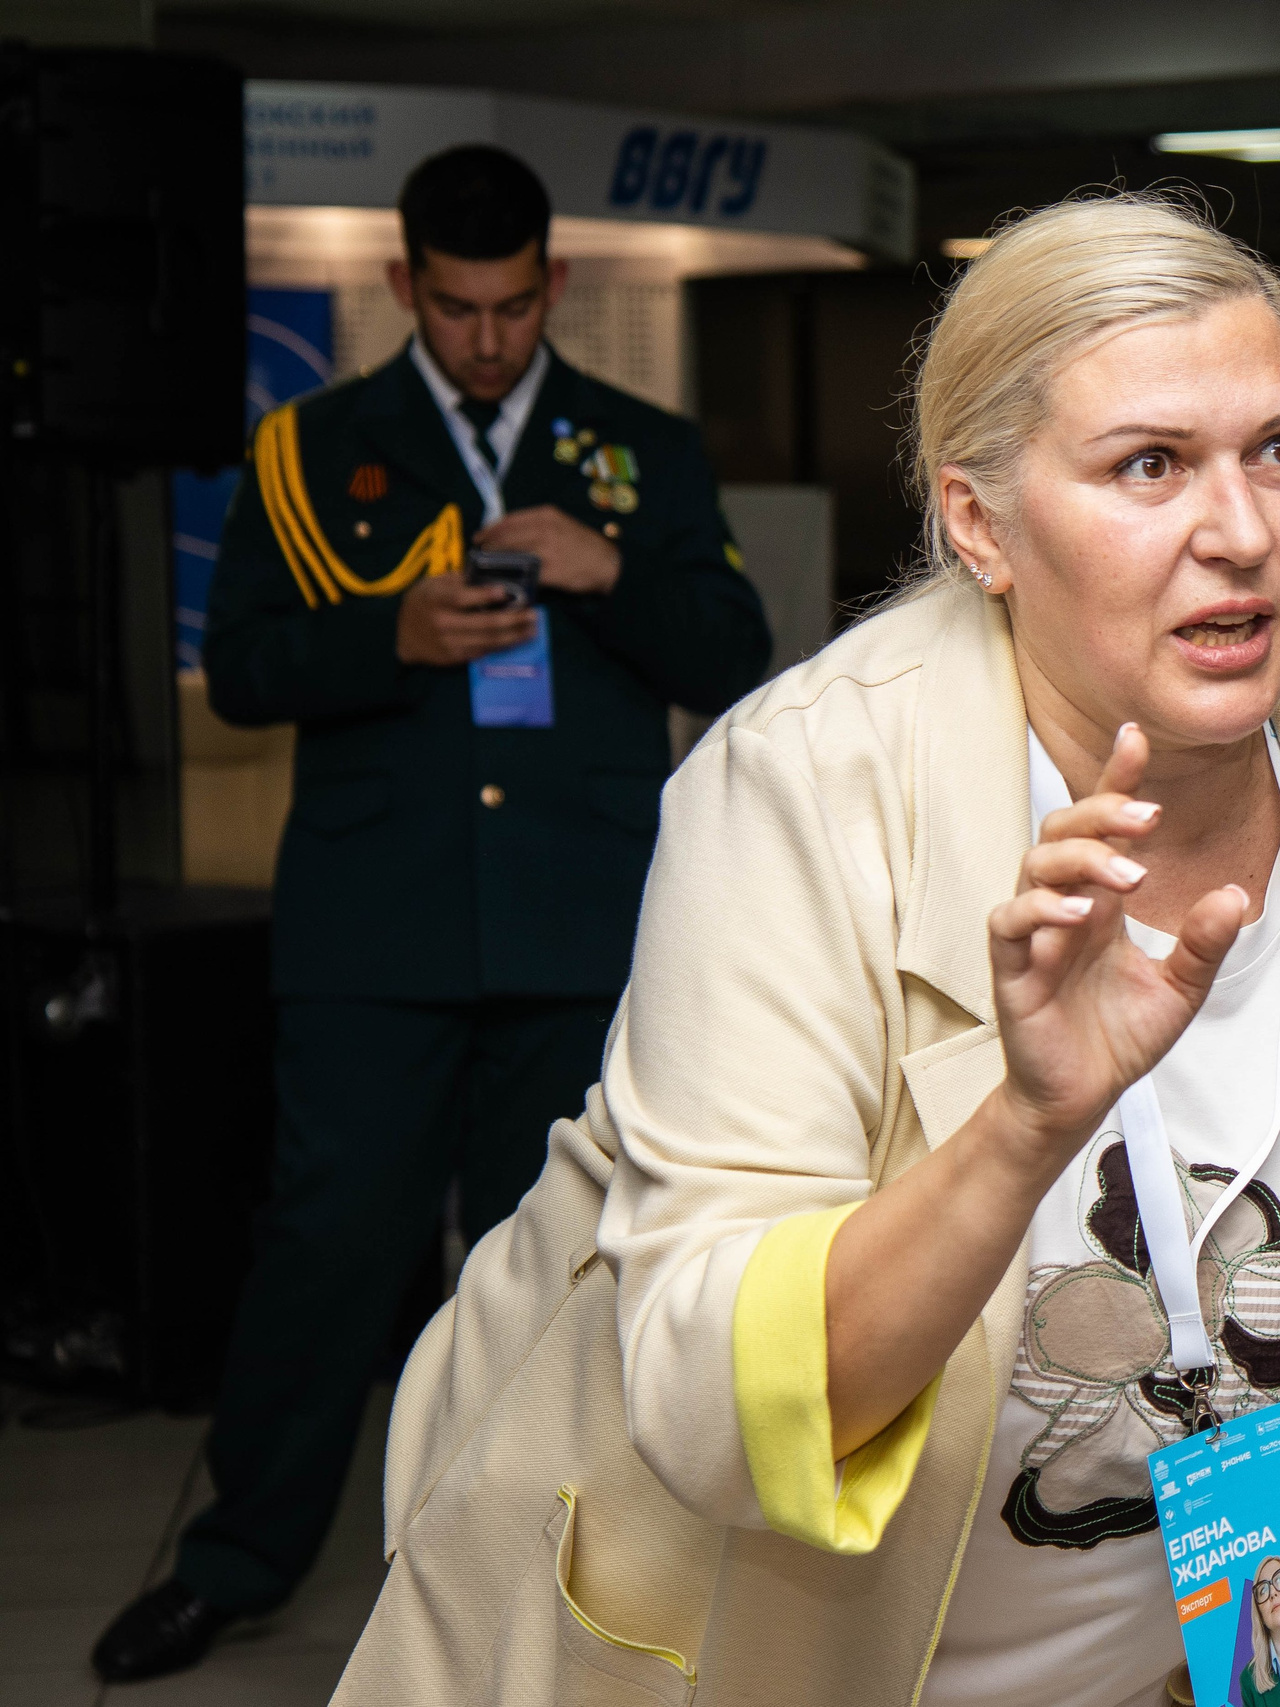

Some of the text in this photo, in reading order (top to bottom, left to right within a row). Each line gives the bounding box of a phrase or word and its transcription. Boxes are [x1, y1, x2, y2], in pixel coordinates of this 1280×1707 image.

[609, 125, 768, 217] ВВГУ
[1168, 1516, 1235, 1561] ЕЛЕНА
[1173, 1526, 1277, 1588] ЖДАНОВА
[1180, 1592, 1213, 1616] Эксперт
